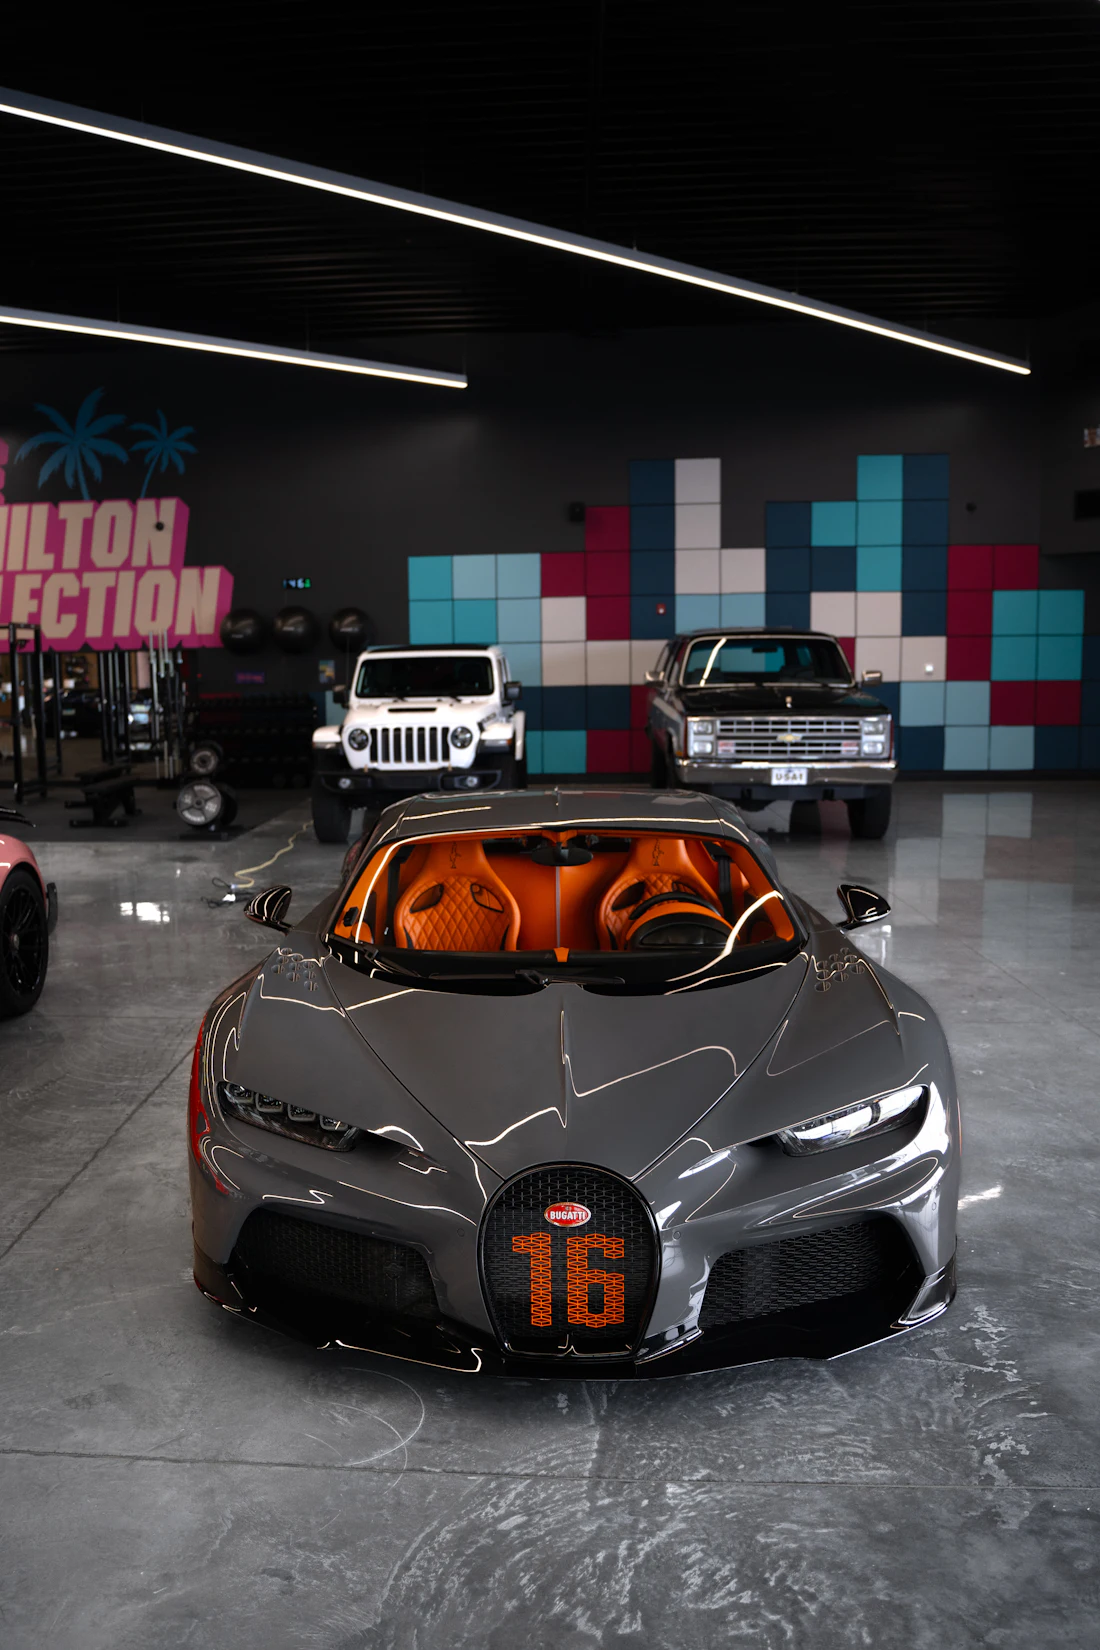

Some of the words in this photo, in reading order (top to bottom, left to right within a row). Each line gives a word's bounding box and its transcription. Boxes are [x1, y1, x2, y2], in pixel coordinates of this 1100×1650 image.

[0, 498, 177, 571] ILTON
[0, 567, 221, 640] ECTION
[550, 1210, 587, 1220] BUGATTI
[512, 1232, 625, 1328] 16
